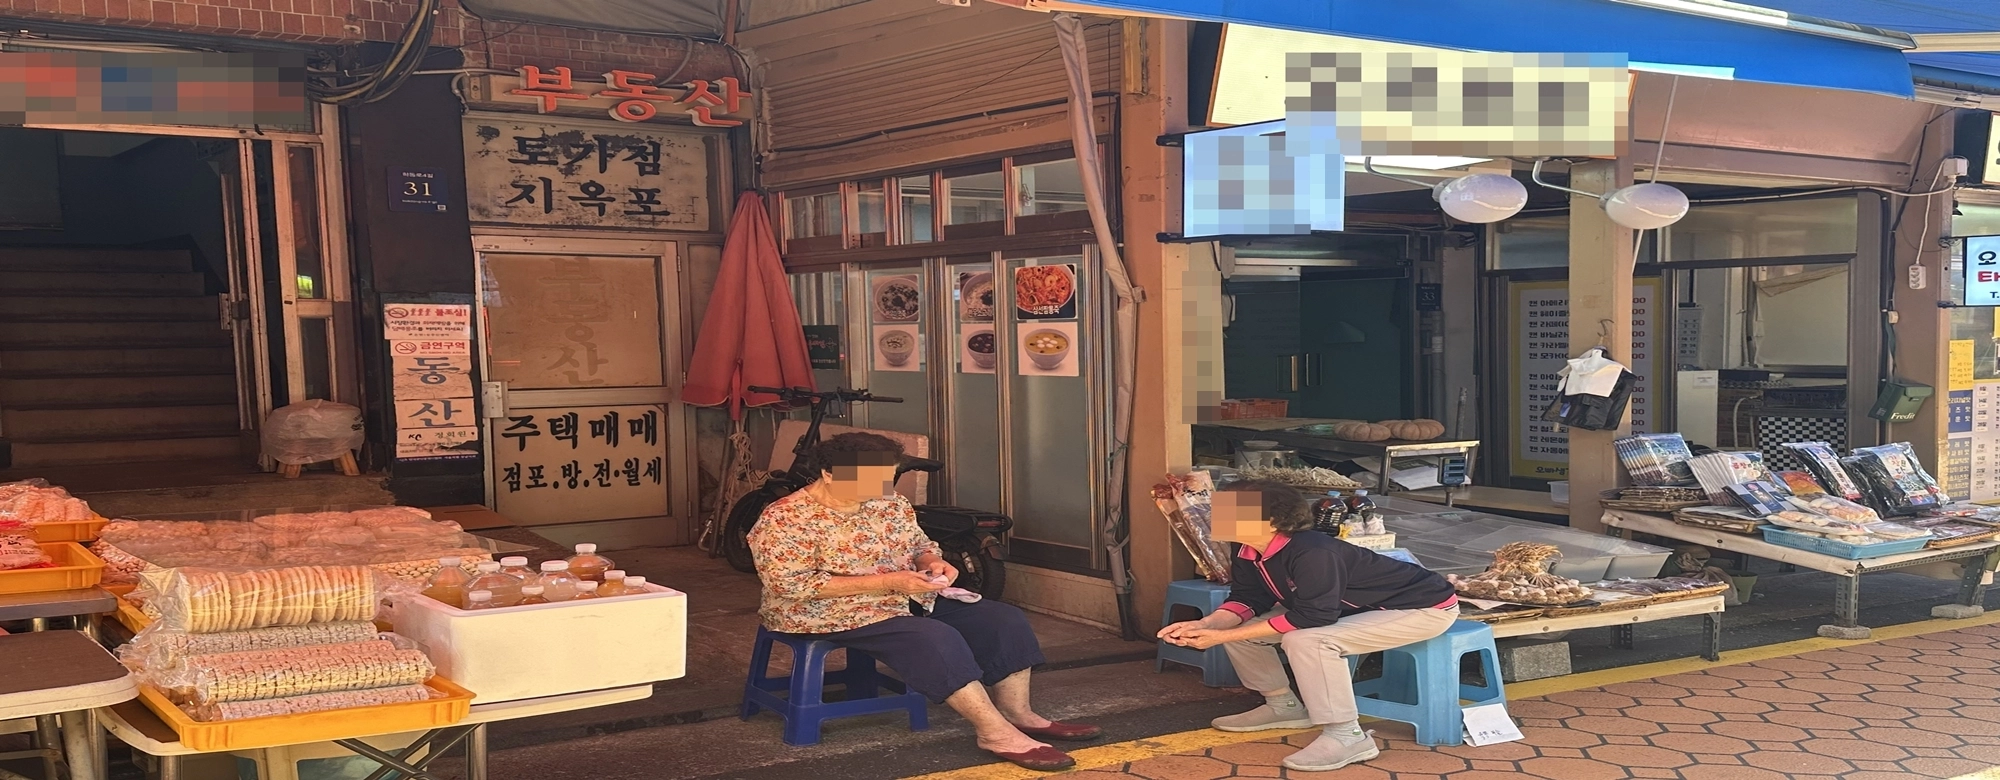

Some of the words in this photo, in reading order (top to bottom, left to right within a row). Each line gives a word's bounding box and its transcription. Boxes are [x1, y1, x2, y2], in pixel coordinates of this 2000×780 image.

[506, 64, 752, 126] 부동산
[403, 181, 433, 197] 31
[1977, 251, 1997, 266] 오
[1421, 292, 1435, 301] 33
[435, 308, 467, 317] 불조심!
[420, 341, 465, 350] 금연구역
[1890, 412, 1916, 420] Fredit
[501, 409, 659, 452] 주택매매
[1535, 466, 1568, 476] 오빠생
